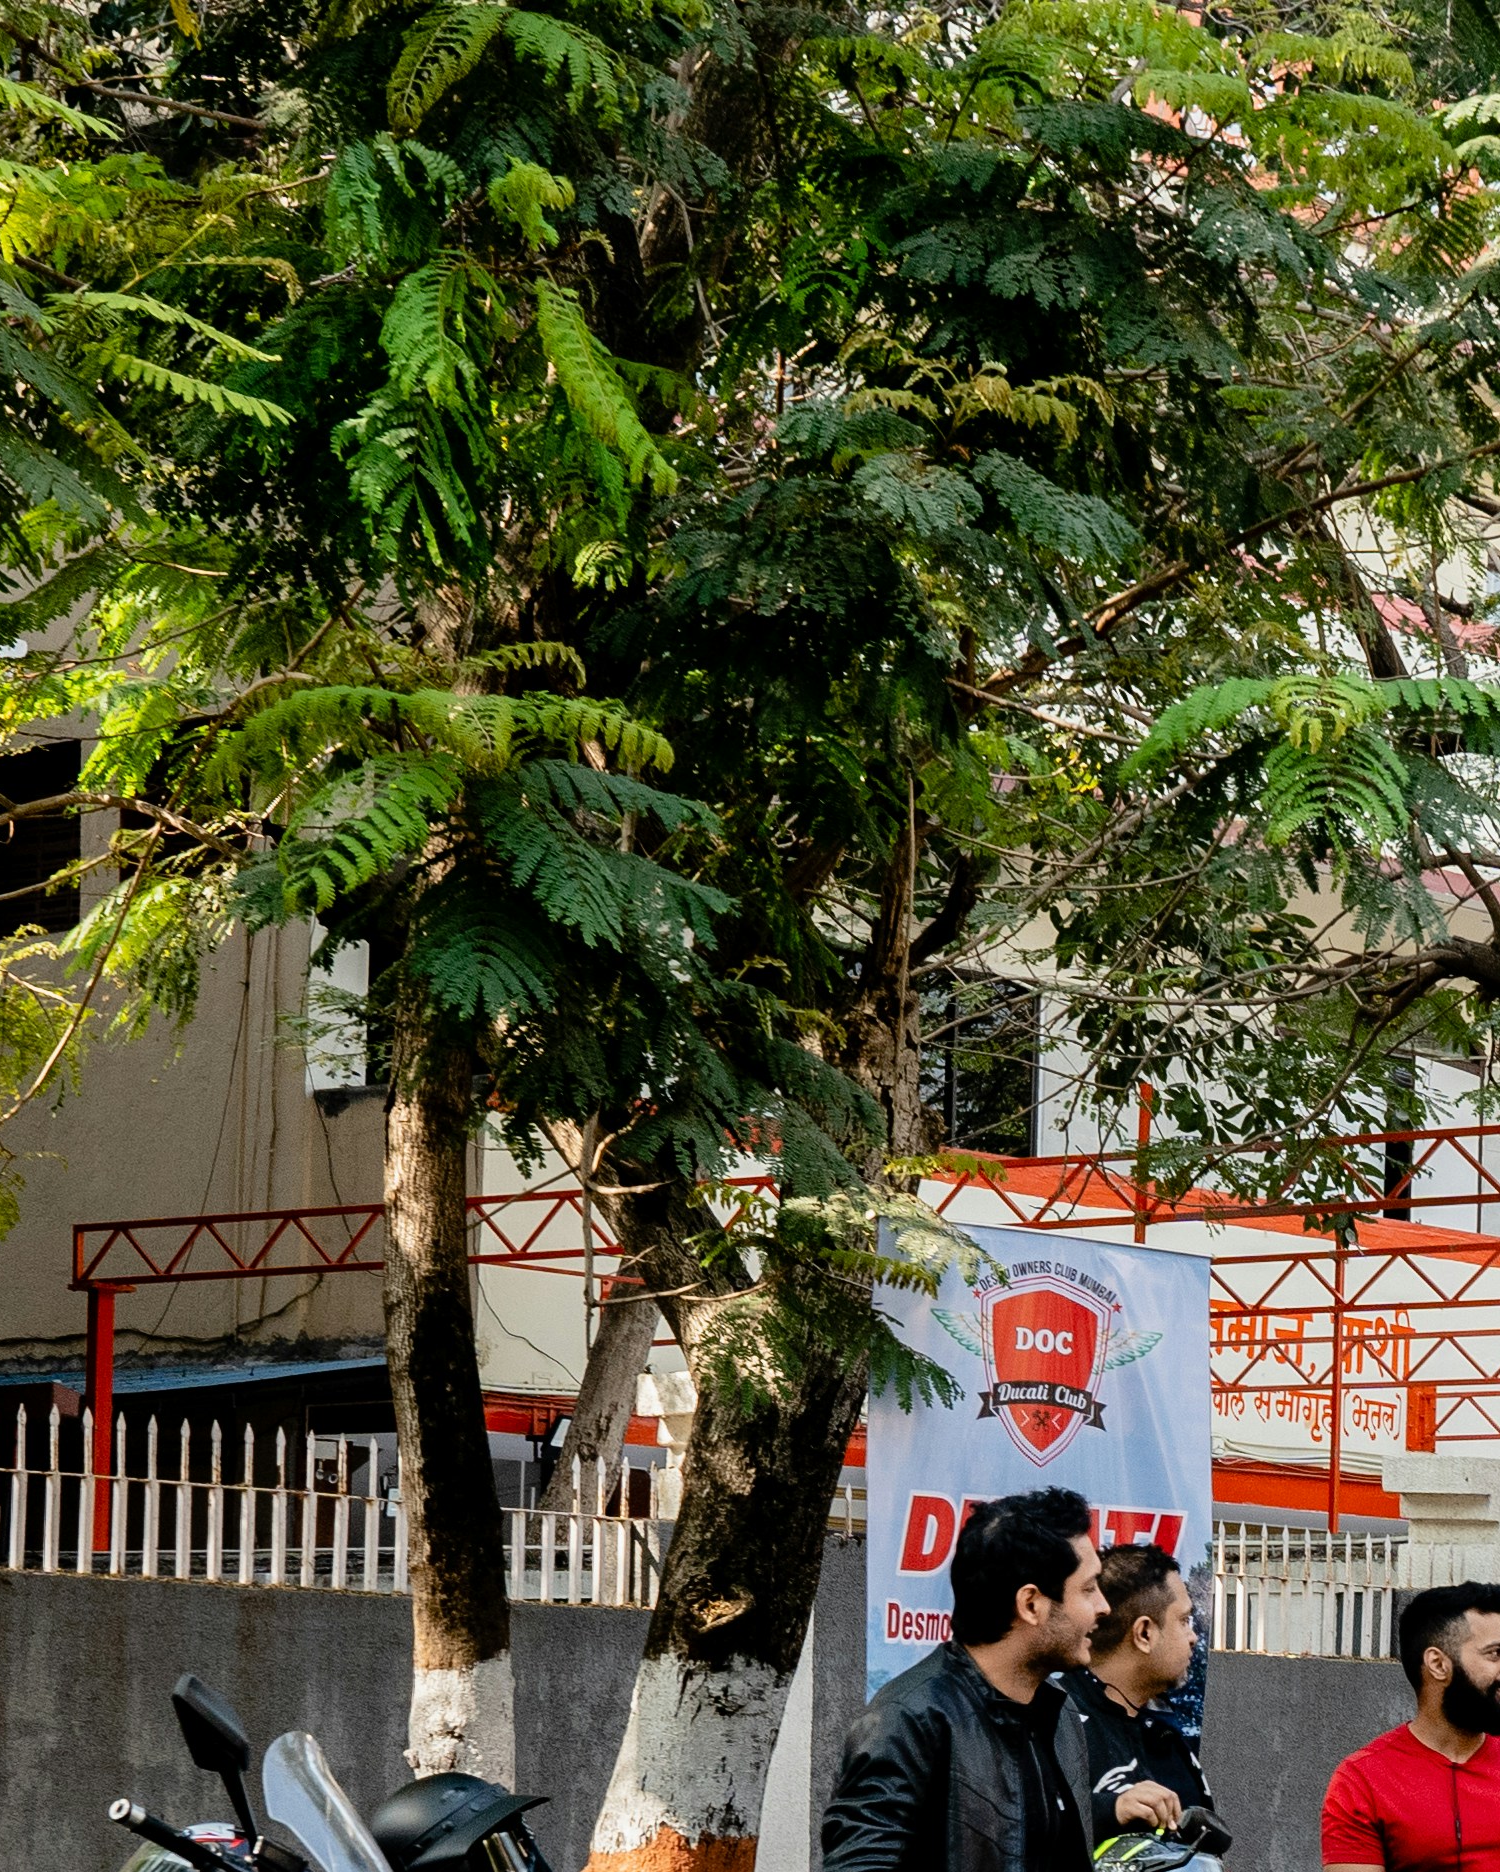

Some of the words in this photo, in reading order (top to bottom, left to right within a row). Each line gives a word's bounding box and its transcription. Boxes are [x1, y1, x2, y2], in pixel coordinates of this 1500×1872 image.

[979, 1266, 1011, 1292] DESO
[1012, 1260, 1052, 1278] OWNERS
[1054, 1263, 1078, 1282] CLUB
[1078, 1272, 1117, 1304] MUMBAI
[1015, 1326, 1074, 1356] DOC
[997, 1382, 1050, 1402] Ducati
[1054, 1385, 1088, 1410] Club
[1342, 1389, 1402, 1441] (भूतल)
[899, 1494, 1185, 1573] DTI
[886, 1602, 950, 1643] Desmo
